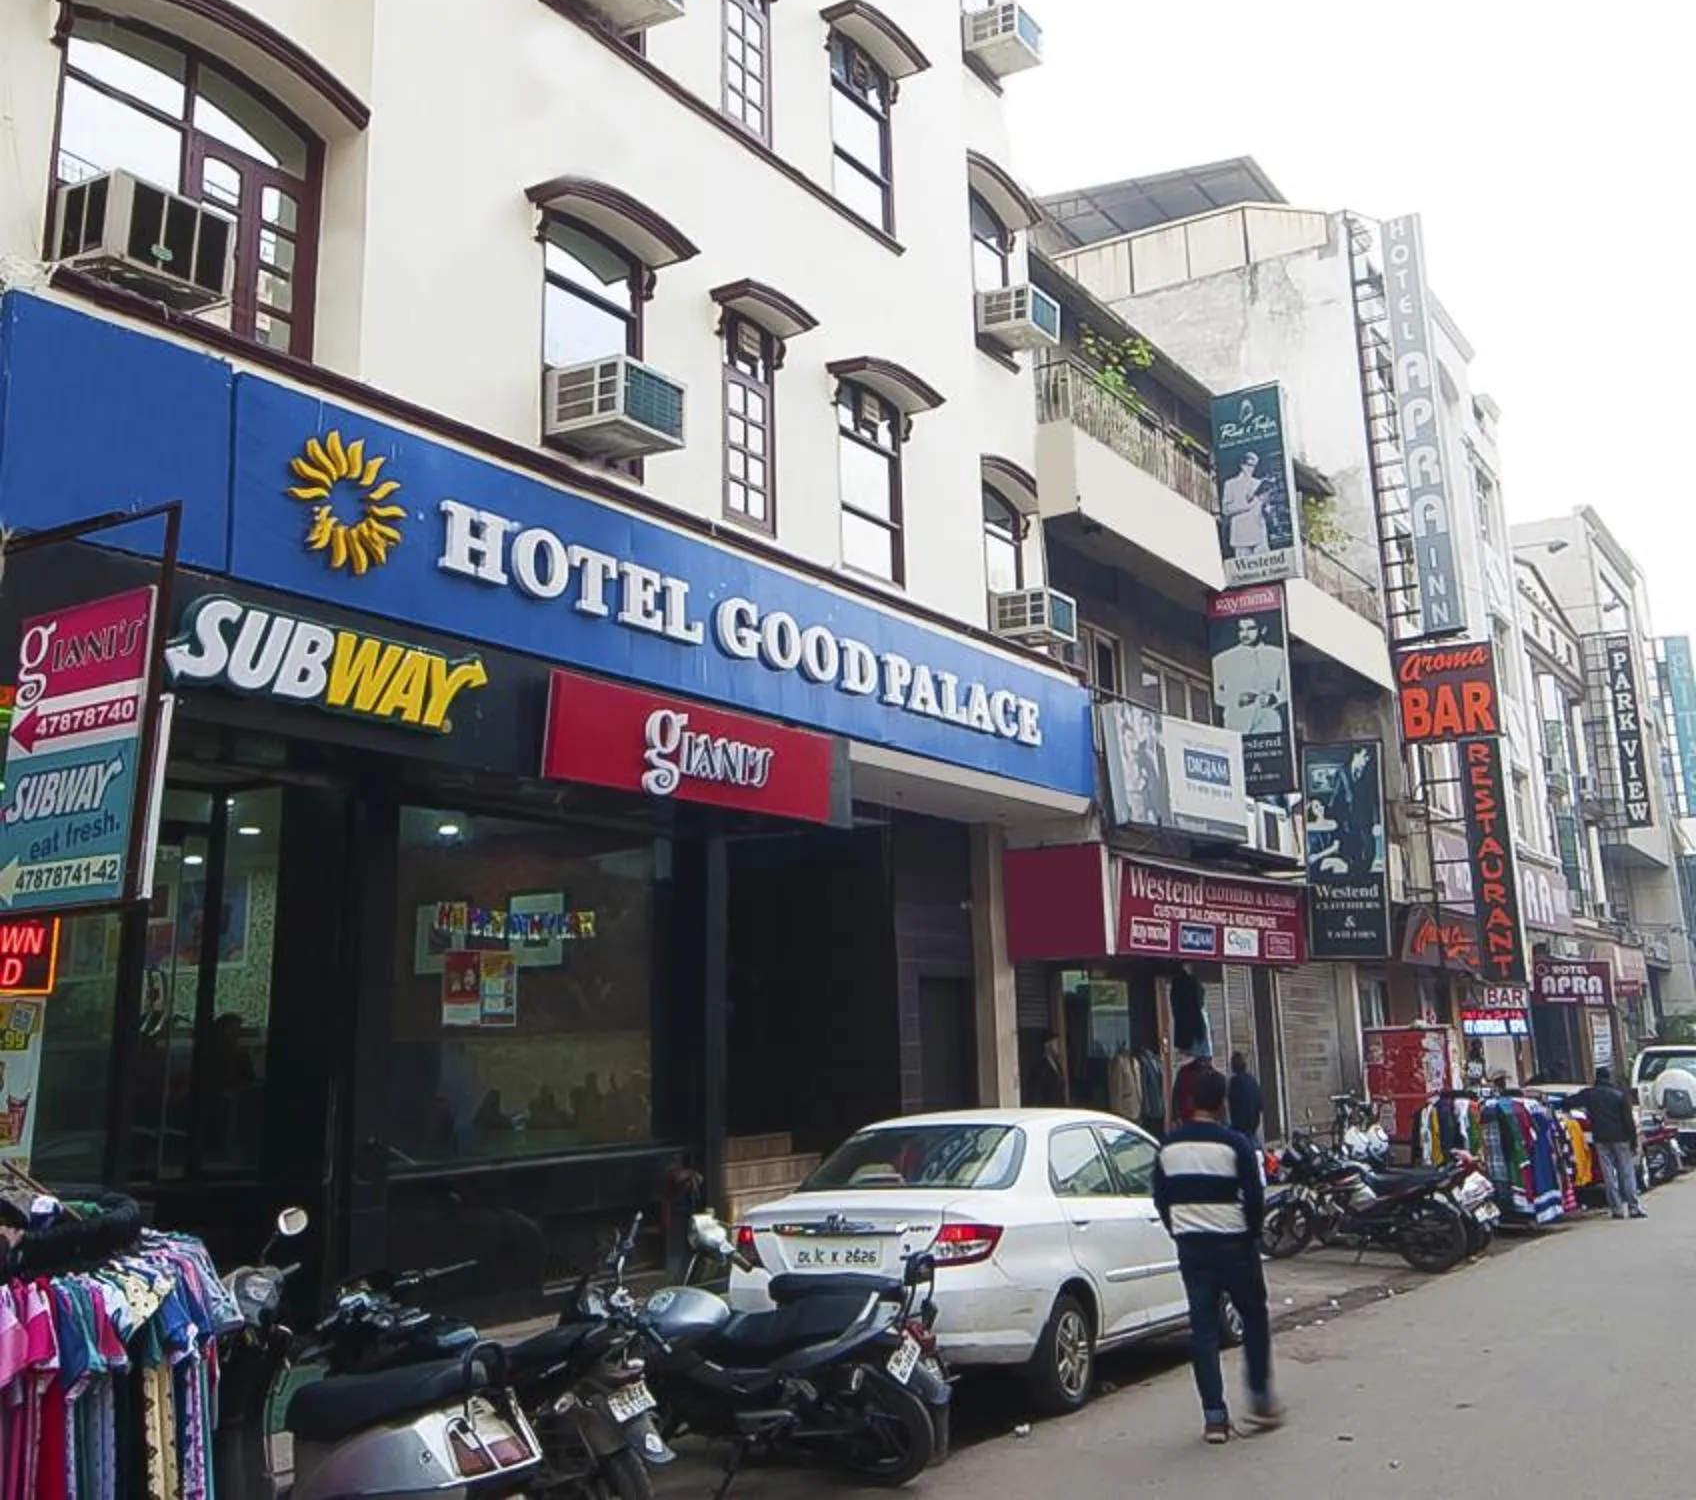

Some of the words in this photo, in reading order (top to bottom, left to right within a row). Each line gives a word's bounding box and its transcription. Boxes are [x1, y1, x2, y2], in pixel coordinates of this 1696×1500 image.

[1388, 220, 1416, 341] HOTEL
[1398, 350, 1447, 535] APRA
[438, 499, 704, 647] HOTEL
[1426, 545, 1451, 628] INN
[166, 598, 489, 729] SUBWAY
[1612, 651, 1637, 731] PARK
[36, 701, 135, 737] 47878740
[1401, 681, 1496, 741] BAR
[5, 753, 125, 826] SUBWAY
[1621, 739, 1649, 822] VIEW
[15, 861, 118, 890] 47878741-42
[29, 831, 60, 861] eat
[1466, 741, 1517, 984] RESTAURANT
[1129, 866, 1204, 905] Westend
[1315, 884, 1379, 899] Westend
[1344, 915, 1357, 929] &
[1486, 987, 1525, 1006] BAR
[1540, 975, 1604, 995] APRA
